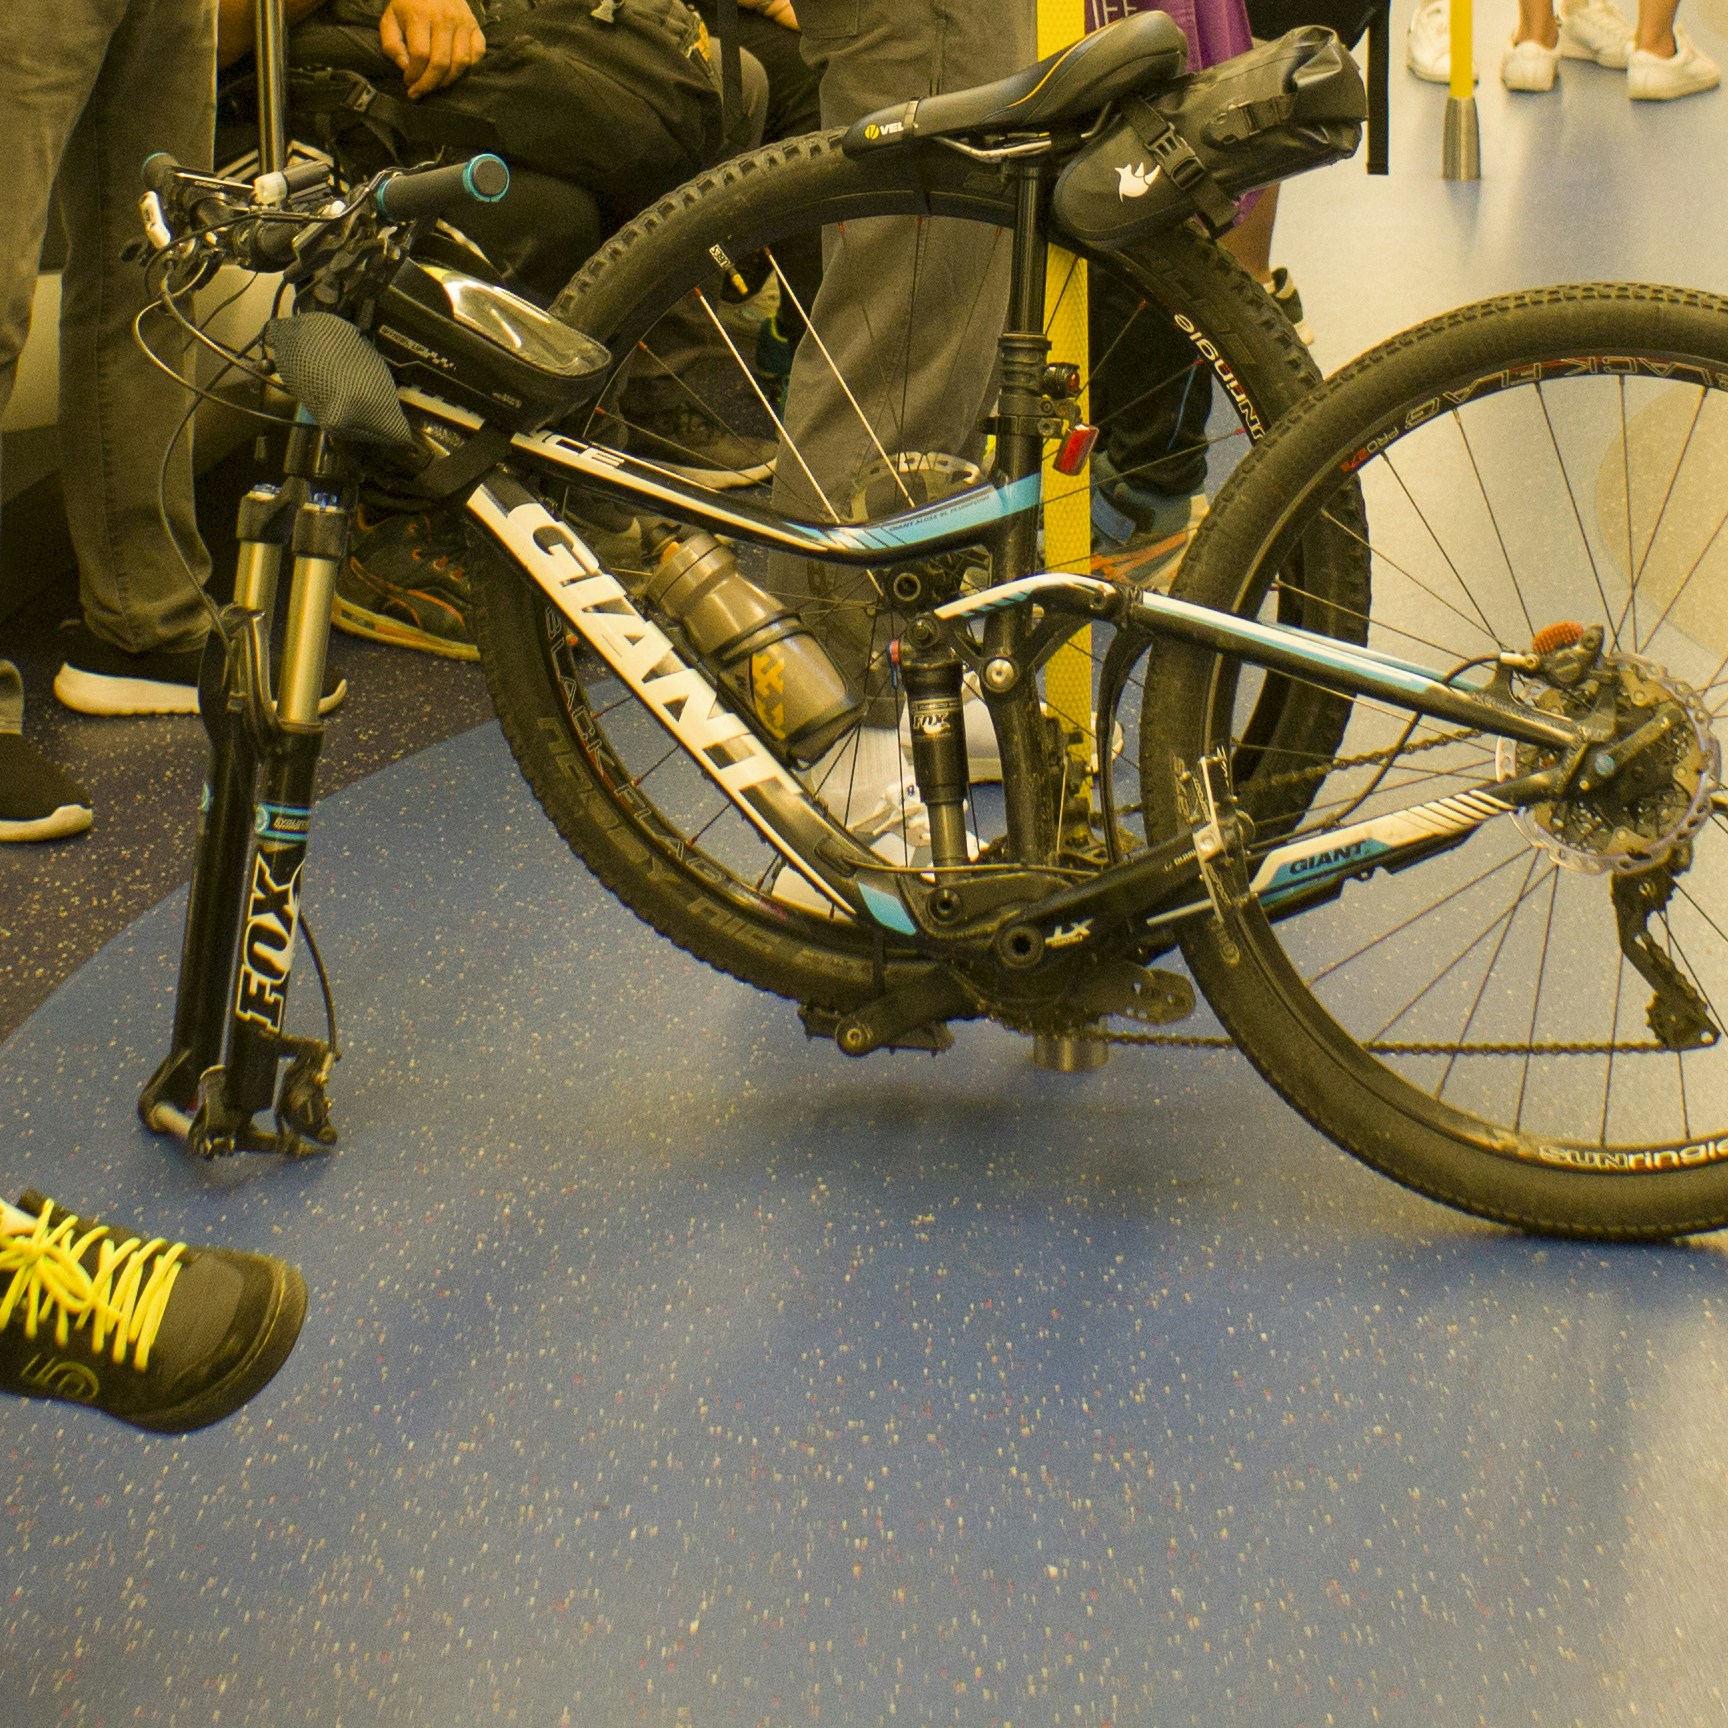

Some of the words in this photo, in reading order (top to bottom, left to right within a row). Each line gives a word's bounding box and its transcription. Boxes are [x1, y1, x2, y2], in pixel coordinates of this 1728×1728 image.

[879, 121, 904, 136] VEL
[508, 501, 803, 792] GIANT
[546, 607, 615, 769] BLACK
[1289, 839, 1364, 874] GIANT
[235, 850, 305, 1034] FOX
